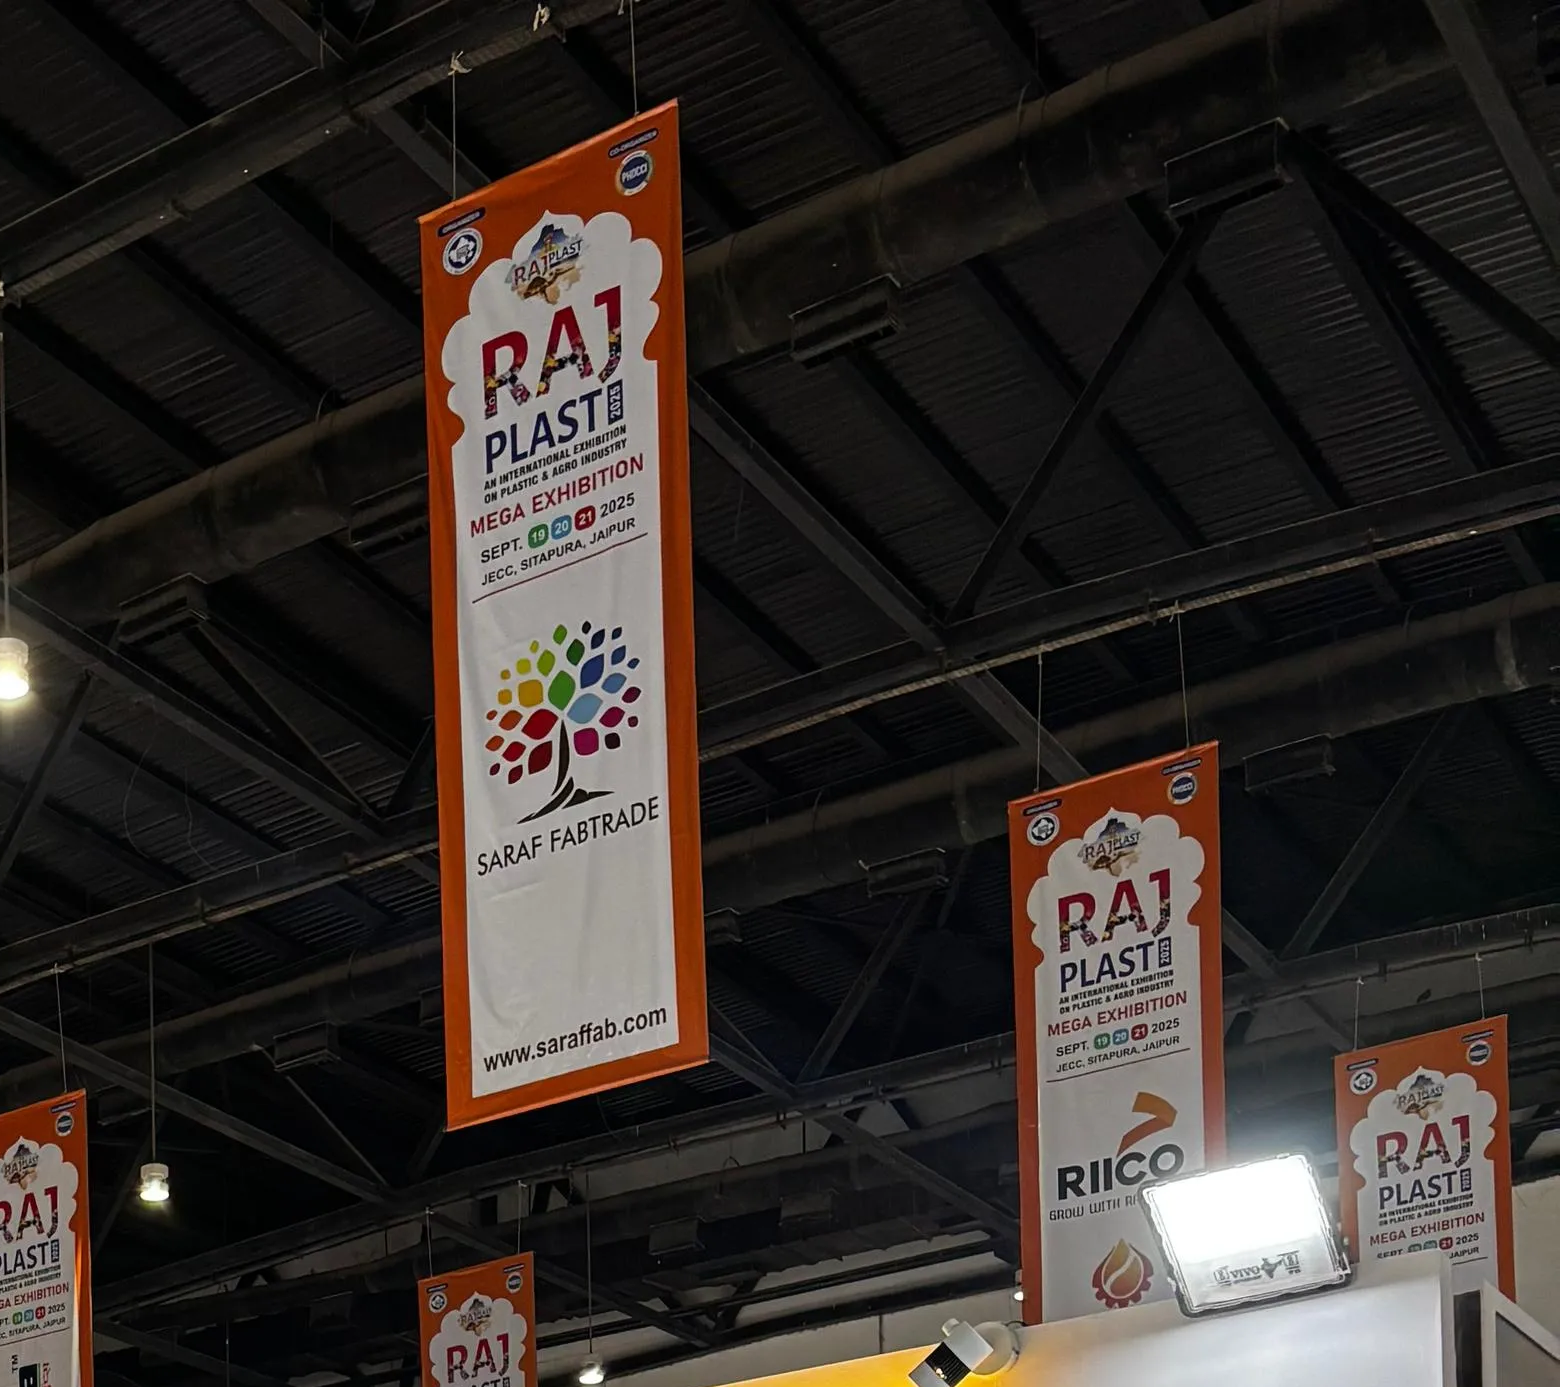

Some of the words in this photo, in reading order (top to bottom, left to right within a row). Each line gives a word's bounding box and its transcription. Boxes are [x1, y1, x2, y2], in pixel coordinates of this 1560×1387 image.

[481, 285, 622, 420] RAJ
[484, 477, 496, 490] AN
[500, 448, 571, 485] INTERNATIONAL
[574, 425, 626, 454] EXHIBITION
[485, 388, 603, 474] PLAST
[608, 379, 624, 425] 2025
[470, 503, 525, 537] MEGA
[533, 453, 644, 514] EXHIBITION
[484, 491, 497, 503] ON
[501, 474, 538, 498] PLASTIC
[542, 470, 548, 481] &
[552, 459, 577, 477] AGRO
[582, 438, 627, 465] INDUSTRY
[481, 537, 522, 563] SEPT.
[532, 529, 545, 542] 19
[555, 521, 568, 534] 20
[579, 511, 592, 525] 21
[601, 492, 635, 518] 2025
[482, 565, 517, 585] JECC,
[521, 538, 586, 571] SITAPURA,
[590, 517, 635, 544] JAIPUR
[477, 836, 542, 877] SARAF
[551, 796, 660, 854] FABTRADE
[1057, 868, 1172, 954] RAJ
[1060, 943, 1155, 993] PLAST
[483, 1005, 668, 1073] www.saraffab.com
[1047, 1014, 1092, 1038] MEGA
[1097, 991, 1188, 1026] EXHIBITION
[1056, 1038, 1090, 1057] SEPT.
[1151, 1017, 1180, 1035] 2025
[1056, 1057, 1086, 1074] JECC,
[1087, 1044, 1140, 1067] SITAPURA,
[1142, 1036, 1180, 1054] JAIPUR
[1056, 1143, 1185, 1201] RIICO
[1376, 1114, 1471, 1179] RAJ
[1379, 1170, 1458, 1210] PLAST
[1370, 1230, 1407, 1246] MEGA
[1410, 1212, 1485, 1238] EXHIBITION
[446, 1333, 509, 1384] RAJ
